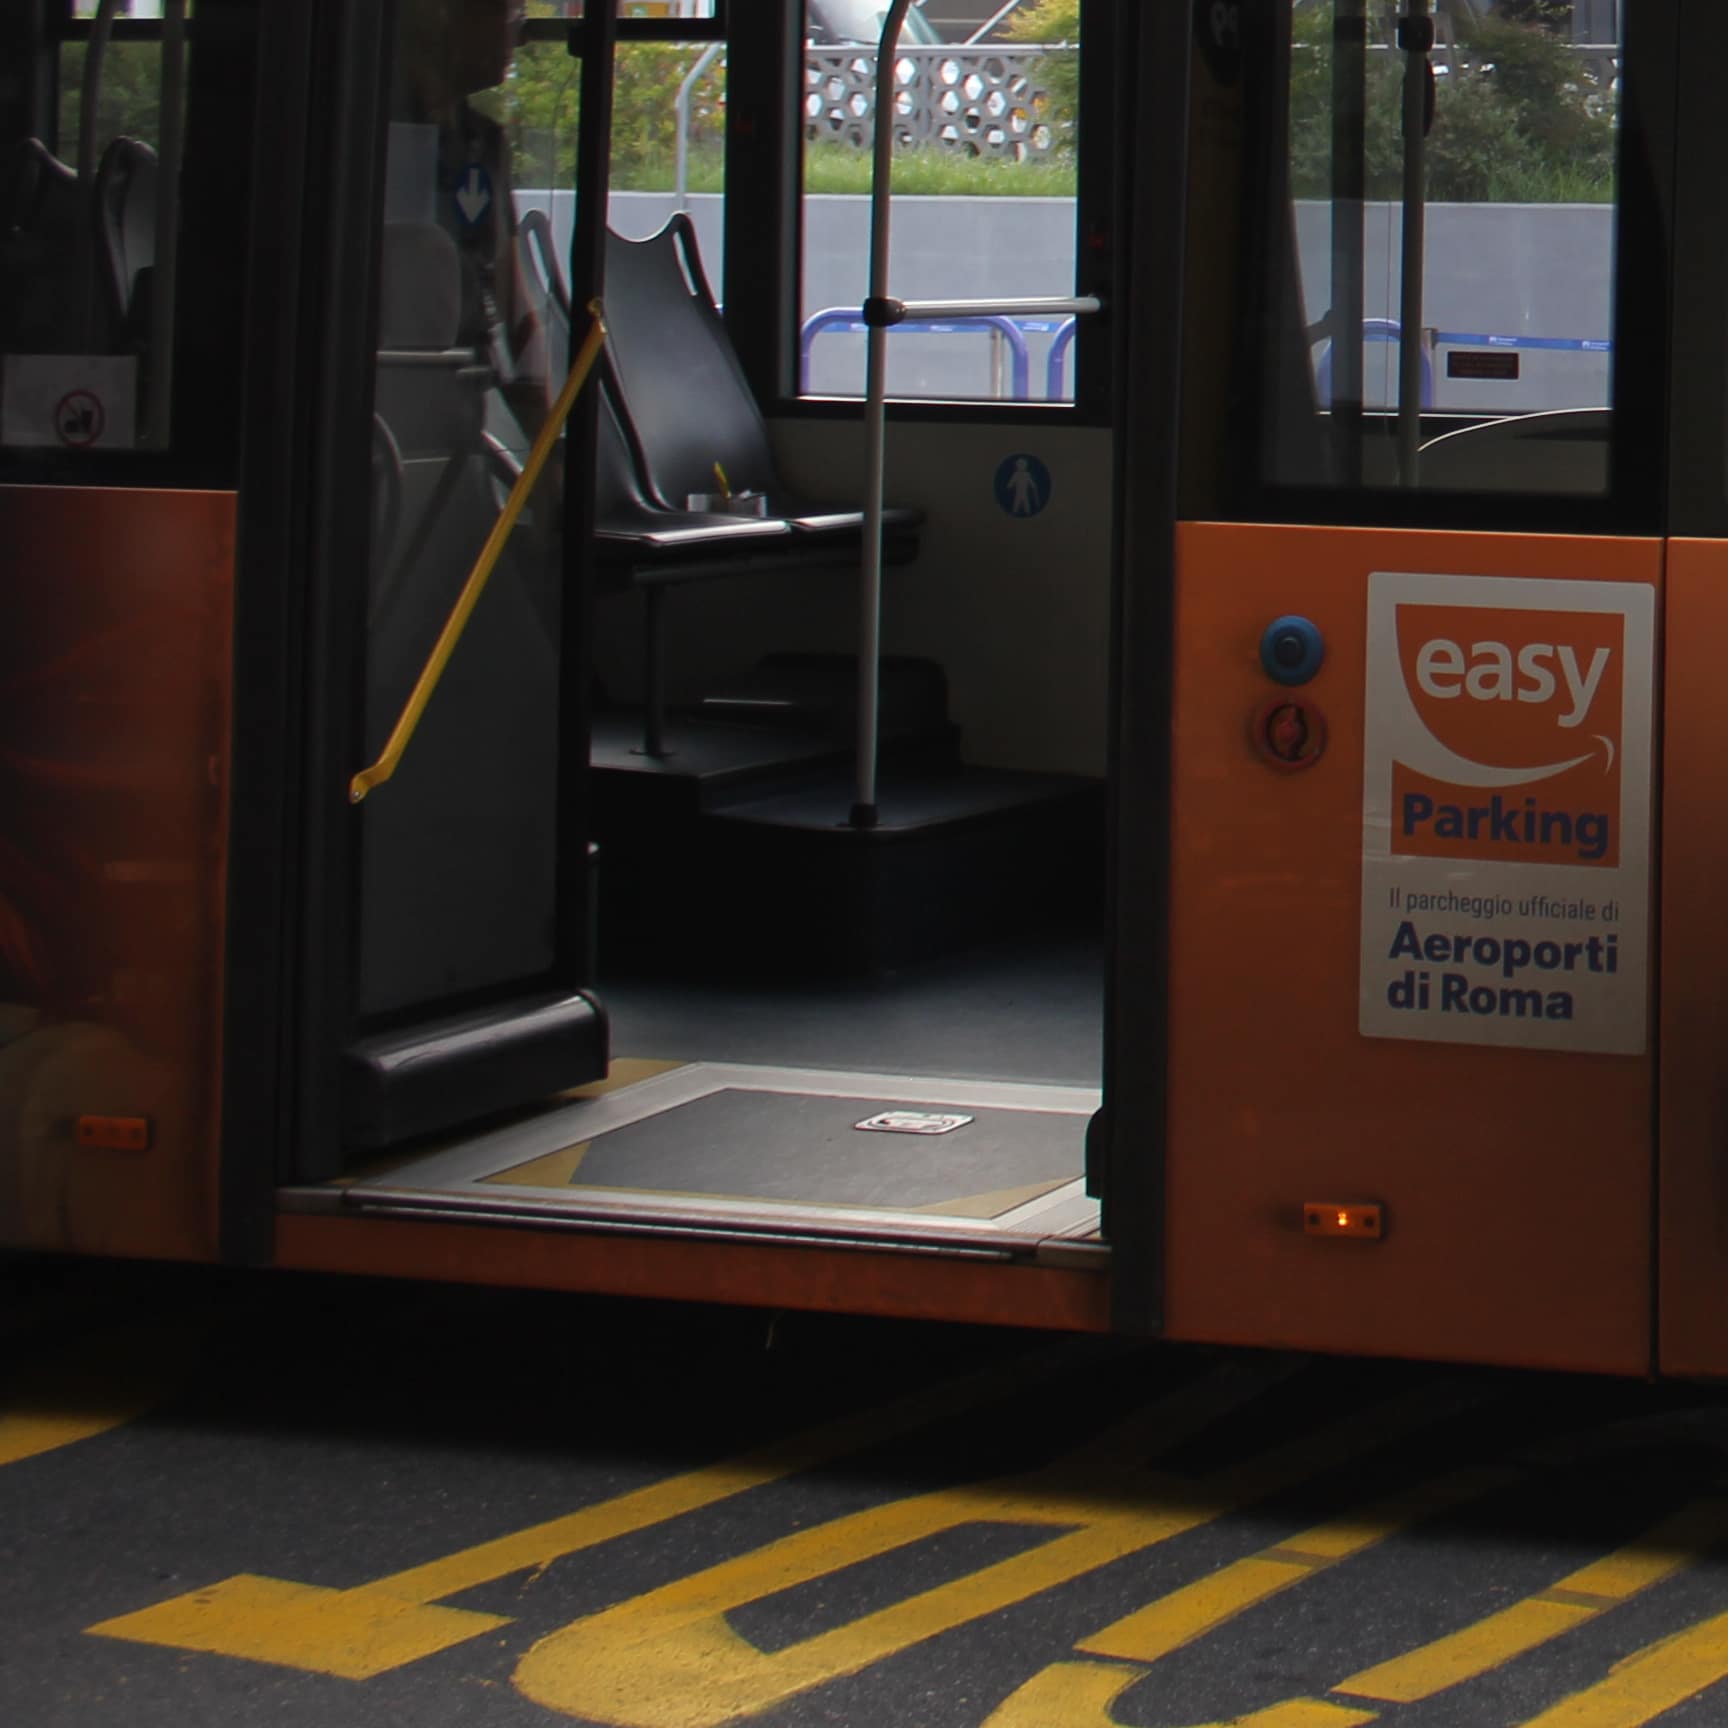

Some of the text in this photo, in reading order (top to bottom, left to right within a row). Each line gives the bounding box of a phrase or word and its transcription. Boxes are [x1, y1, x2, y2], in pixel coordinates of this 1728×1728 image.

[1415, 637, 1611, 729] easy
[1402, 793, 1610, 860] Parking
[1389, 887, 1619, 922] Il parcheggio ufficiale di
[1388, 920, 1619, 979] Aeroporti
[1387, 971, 1575, 1020] di Roma
